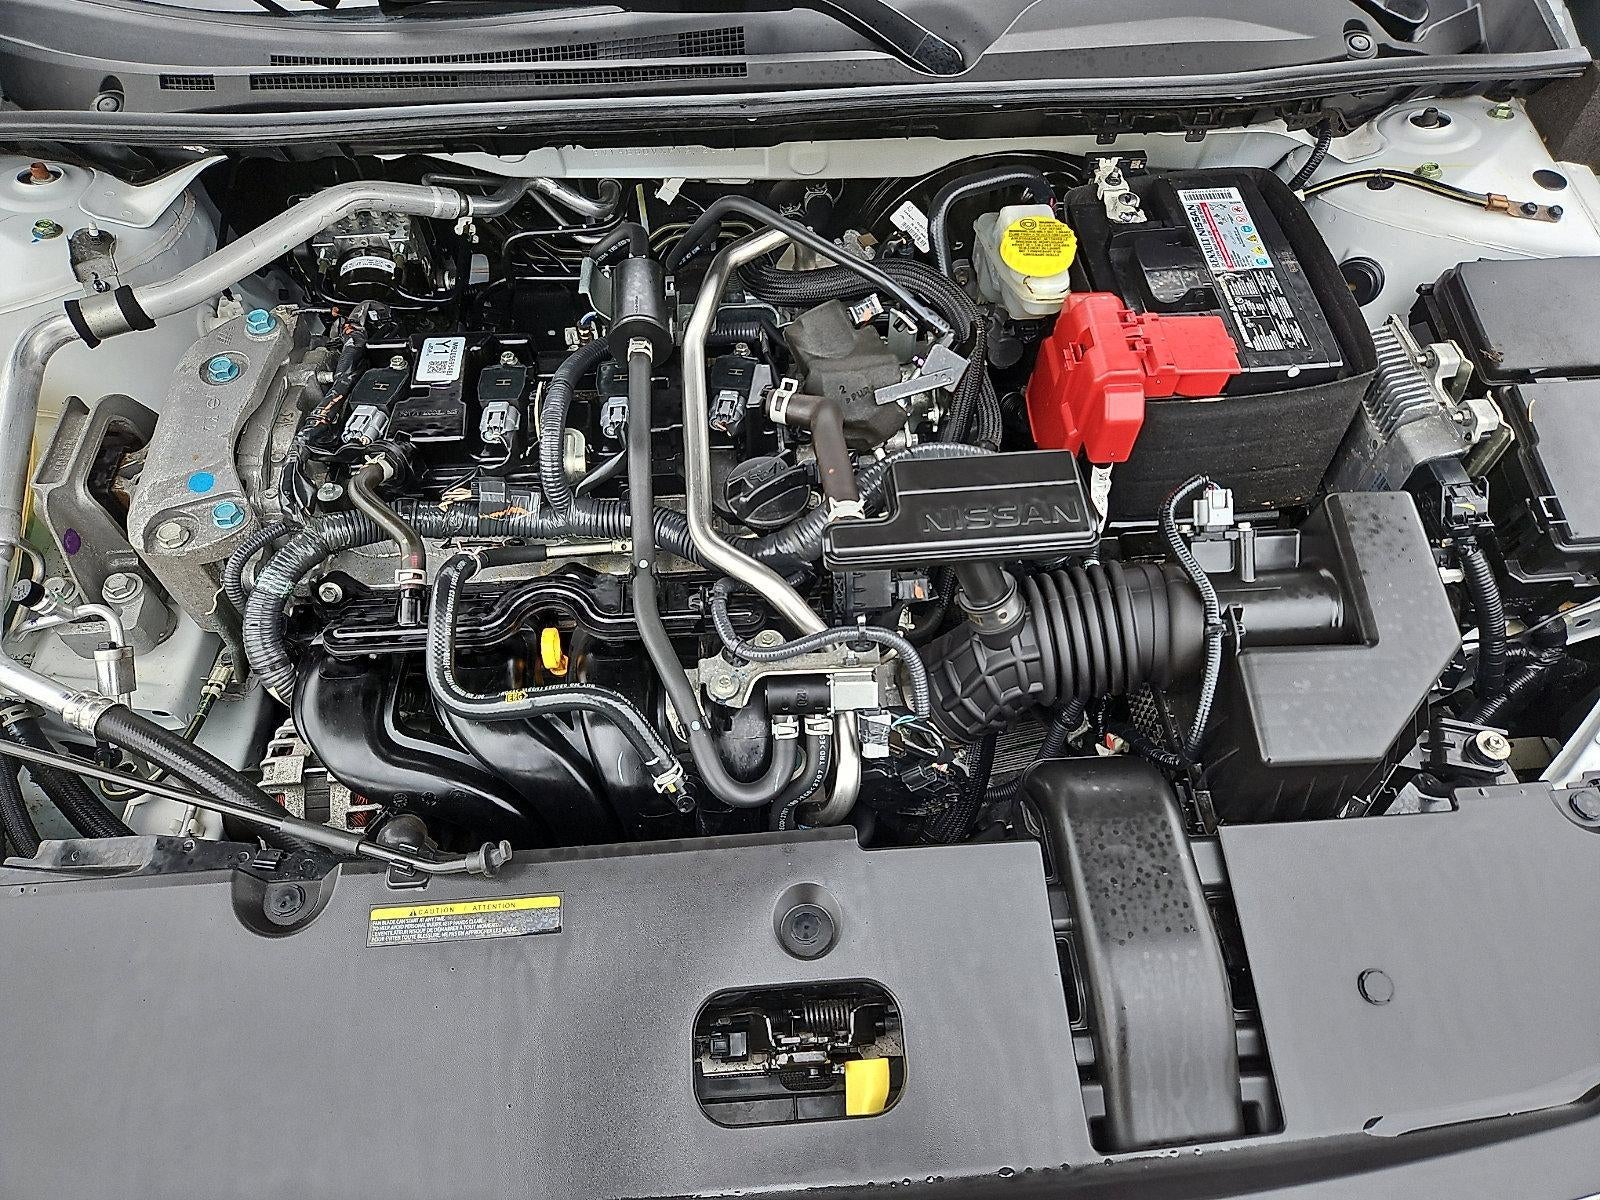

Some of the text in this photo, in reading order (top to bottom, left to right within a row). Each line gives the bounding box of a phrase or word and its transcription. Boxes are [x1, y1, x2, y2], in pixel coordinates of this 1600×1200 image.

[1186, 204, 1208, 237] NISSAN
[922, 501, 1081, 533] NISSAN
[418, 907, 455, 915] CAUTION
[472, 902, 517, 911] ATTENTION
